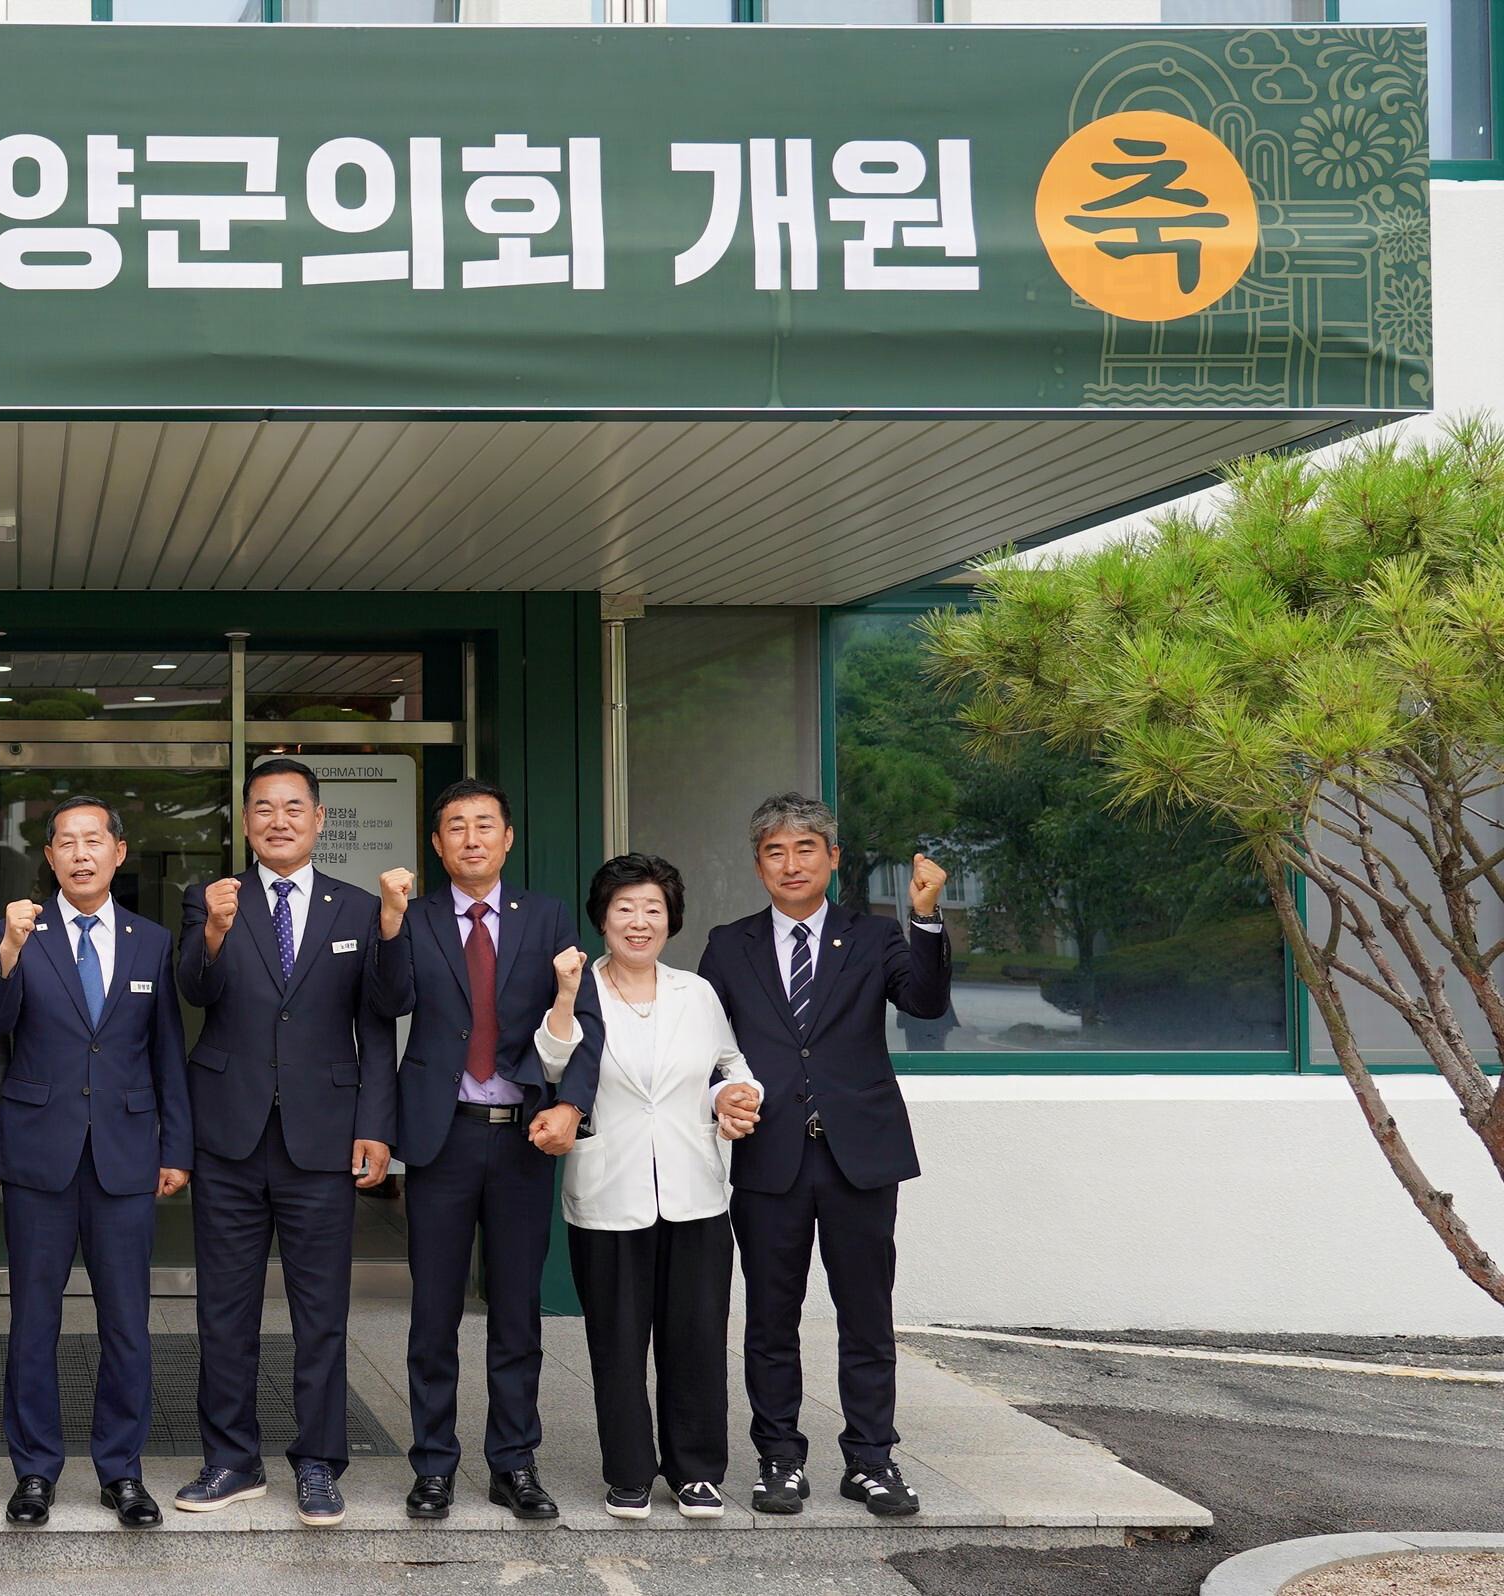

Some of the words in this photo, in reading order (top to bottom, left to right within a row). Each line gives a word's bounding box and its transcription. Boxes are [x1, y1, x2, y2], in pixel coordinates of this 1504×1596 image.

[670, 137, 980, 291] 개원
[1063, 137, 1231, 295] 축
[312, 766, 384, 778] FORMATION
[317, 830, 357, 841] 위원회실
